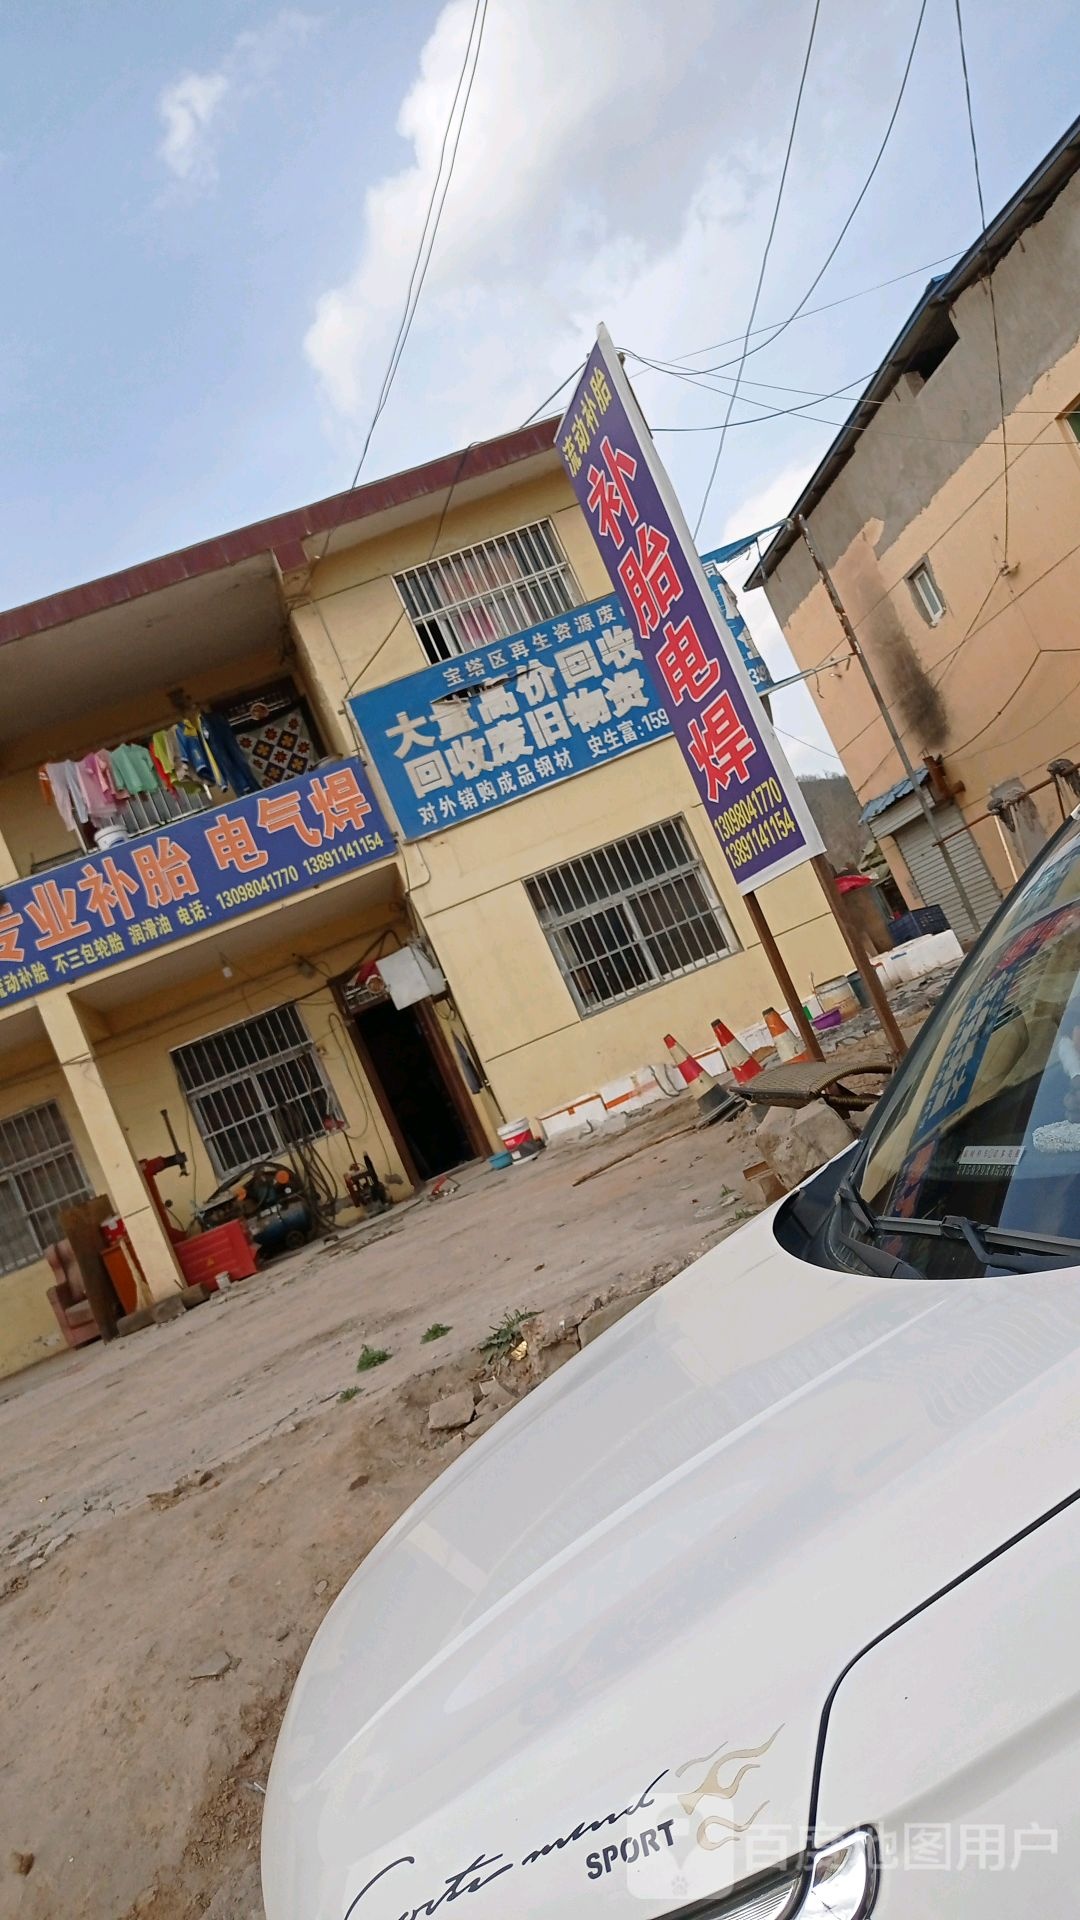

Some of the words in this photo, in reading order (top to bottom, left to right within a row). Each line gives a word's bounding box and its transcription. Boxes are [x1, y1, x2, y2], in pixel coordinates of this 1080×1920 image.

[562, 366, 612, 477] 流动补胎
[443, 604, 626, 686] 宝塔区再生资源废
[587, 436, 757, 803] 补胎电焊
[386, 625, 644, 758] 大量高价回收
[403, 669, 650, 799] 回收废旧物资
[204, 767, 373, 874] 电气焊
[418, 747, 574, 826] 对外销购成品钢材
[714, 777, 782, 842] 13098041770
[725, 807, 796, 869] 13891141154
[52, 934, 125, 975] 不三包轮胎
[128, 914, 171, 946] 润滑油
[216, 866, 299, 911] 13098041770
[303, 831, 384, 877] 13891141154
[585, 1818, 675, 1881] SPORT
